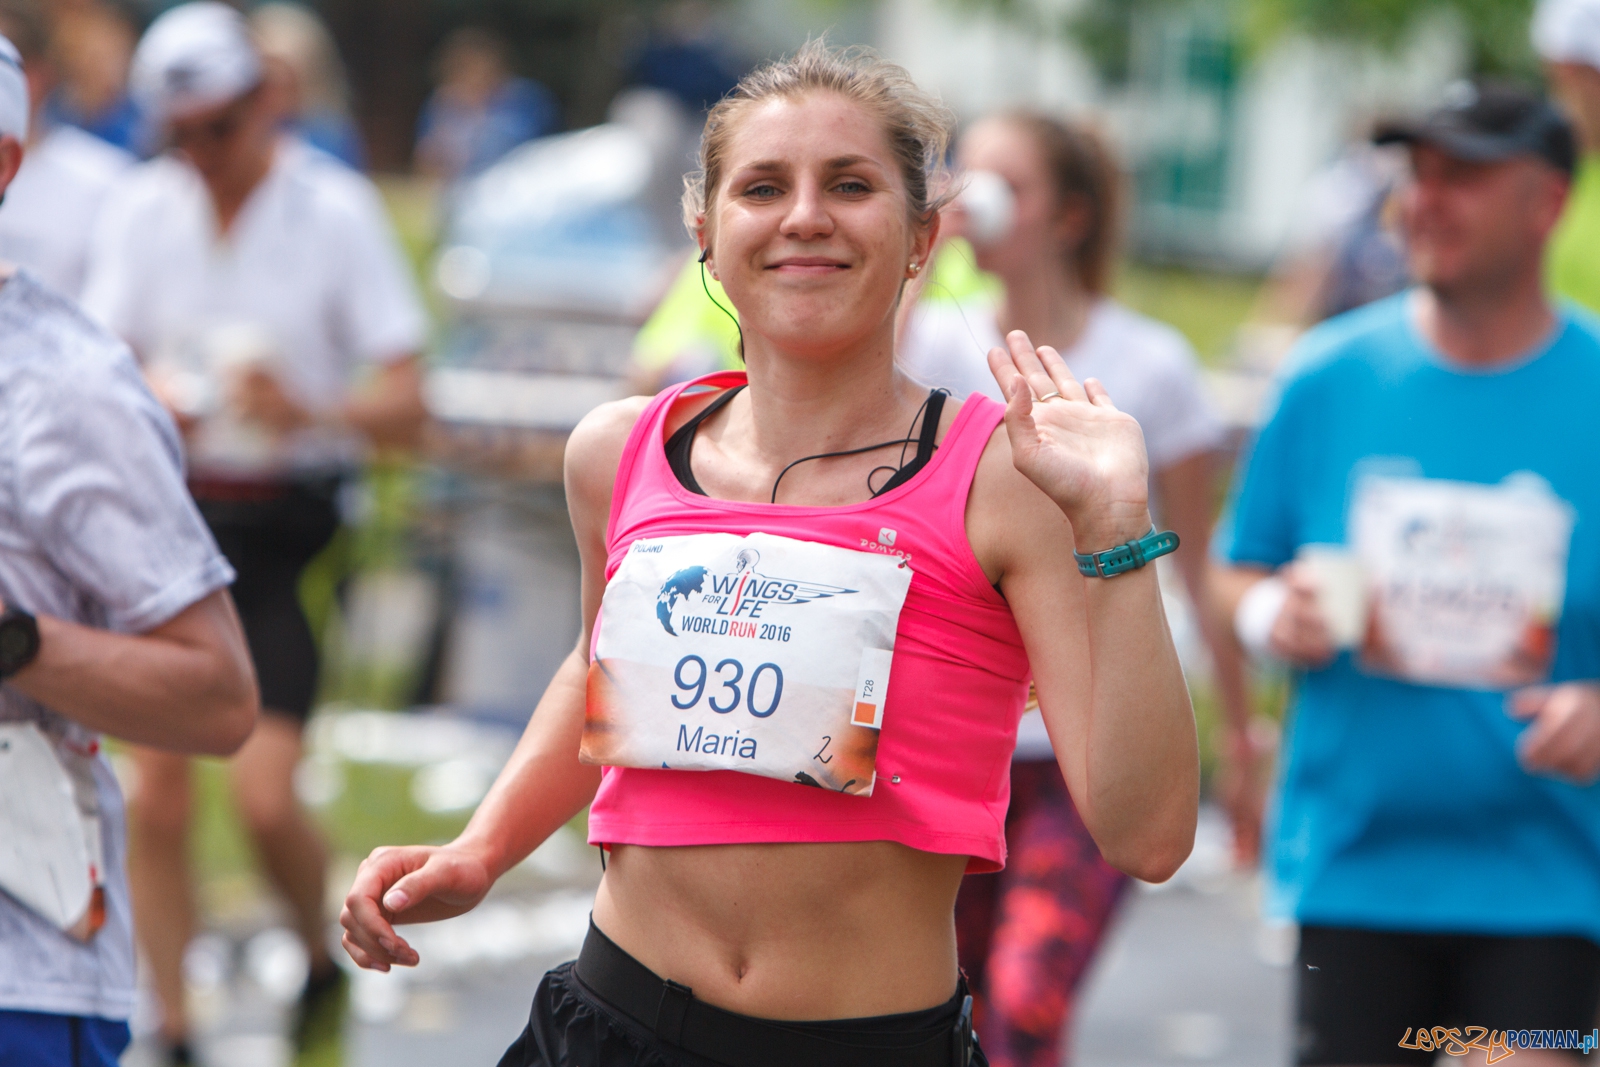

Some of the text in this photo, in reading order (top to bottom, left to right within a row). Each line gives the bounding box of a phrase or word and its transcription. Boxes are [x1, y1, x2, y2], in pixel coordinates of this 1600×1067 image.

[633, 543, 664, 554] POLAND
[702, 594, 722, 604] FOR
[759, 623, 792, 643] 2016
[670, 654, 784, 718] 930
[862, 679, 875, 699] T28
[676, 723, 758, 760] Maria
